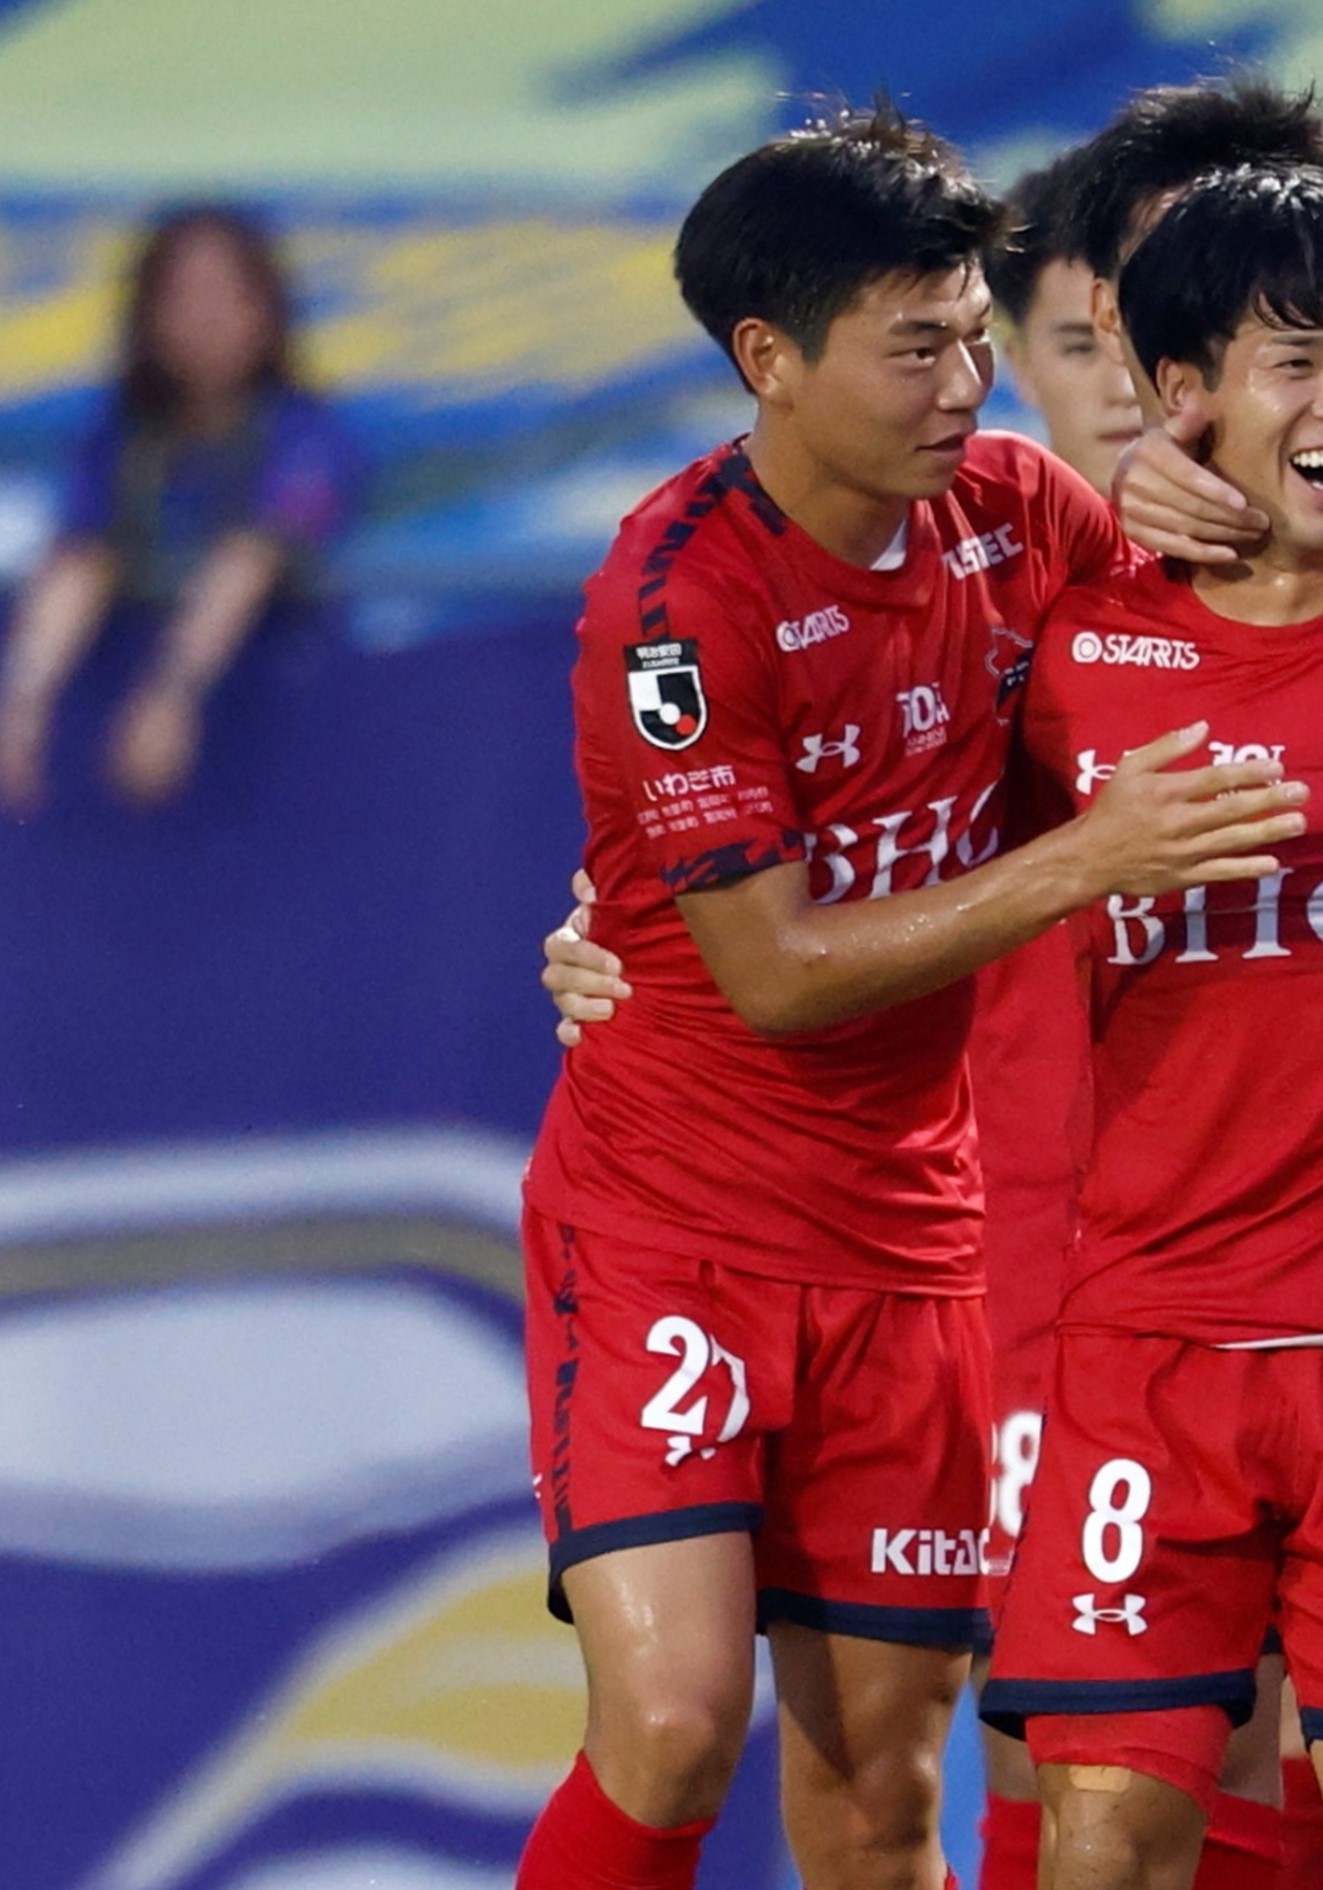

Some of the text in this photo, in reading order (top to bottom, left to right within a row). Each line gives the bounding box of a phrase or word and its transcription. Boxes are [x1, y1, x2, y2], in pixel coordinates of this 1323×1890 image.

[642, 764, 737, 802] いわき市
[988, 1409, 1043, 1539] 8
[1082, 1458, 1152, 1584] 8
